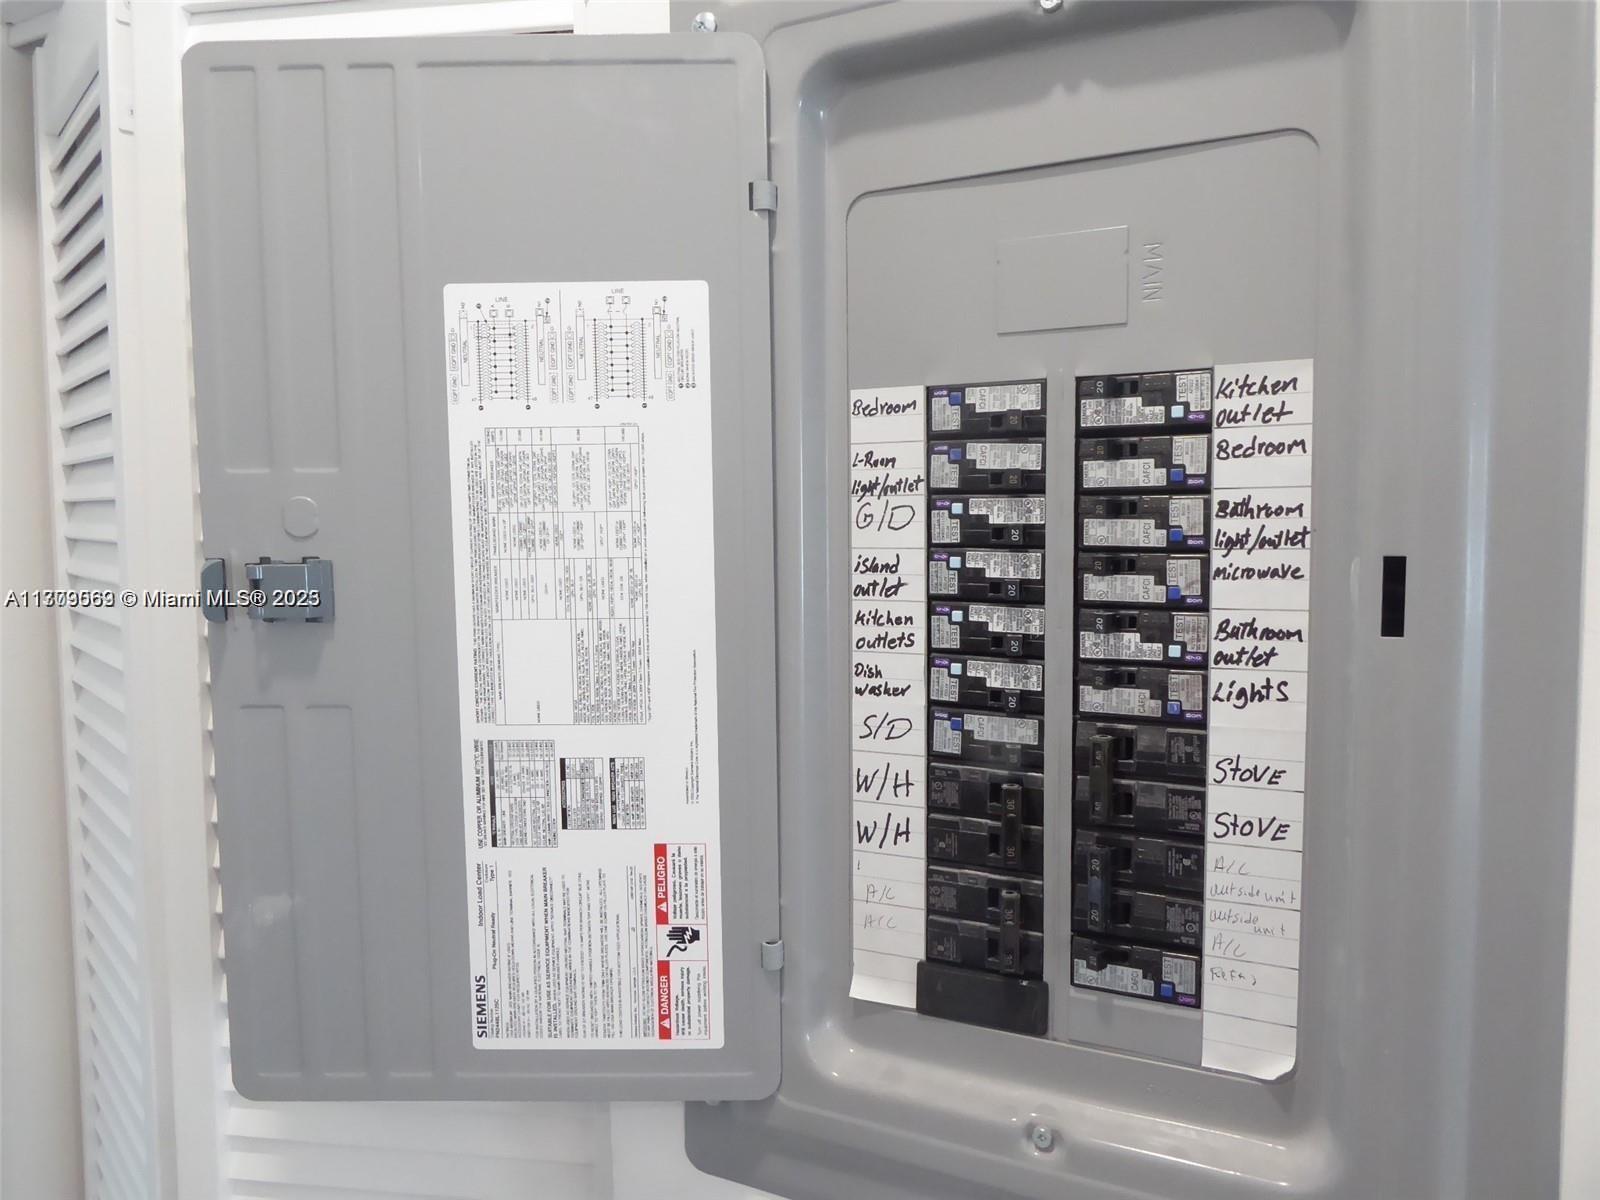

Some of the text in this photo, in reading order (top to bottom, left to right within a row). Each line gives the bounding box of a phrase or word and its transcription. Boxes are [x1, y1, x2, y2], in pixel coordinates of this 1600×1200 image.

[1142, 242, 1164, 303] MAIN
[1096, 381, 1103, 393] 20
[1178, 376, 1186, 399] TEST
[1215, 374, 1298, 399] Kitchen
[852, 397, 917, 417] Bedroom
[1216, 401, 1293, 428] outlet
[1010, 415, 1017, 424] 20
[979, 445, 987, 466] CAFCI
[1174, 440, 1182, 462] TEST
[1216, 435, 1307, 461] Bedroom
[852, 473, 924, 502] light/outlet
[1009, 475, 1017, 484] 20
[1215, 495, 1304, 519] Bathroom
[1012, 529, 1019, 541] 20
[1143, 523, 1151, 544] CAFCI
[1214, 525, 1311, 557] light/outlet
[1095, 561, 1102, 570] 20
[1168, 561, 1176, 584] TEST
[854, 577, 908, 598] outlet
[1008, 584, 1015, 596] 20
[1096, 618, 1103, 630] 20
[1214, 618, 1303, 642] Bathroom
[1011, 640, 1018, 652] 20
[1213, 646, 1279, 668] outlet
[854, 662, 883, 679] Dish
[854, 683, 911, 698] washer
[1170, 676, 1178, 698] TEST
[1009, 696, 1016, 708] 20
[1138, 692, 1146, 713] CAFCI
[859, 712, 913, 740] S/D
[977, 717, 985, 737] CAFCI
[952, 732, 960, 753] TEST
[857, 762, 915, 801] W/H
[857, 812, 910, 849] W/H
[1091, 859, 1099, 871] 20
[657, 856, 666, 898] PELIGRO
[1091, 910, 1099, 922] 20
[1164, 958, 1172, 979] TEST
[660, 975, 669, 1015] DANGER
[475, 975, 487, 1038] SIEMENS
